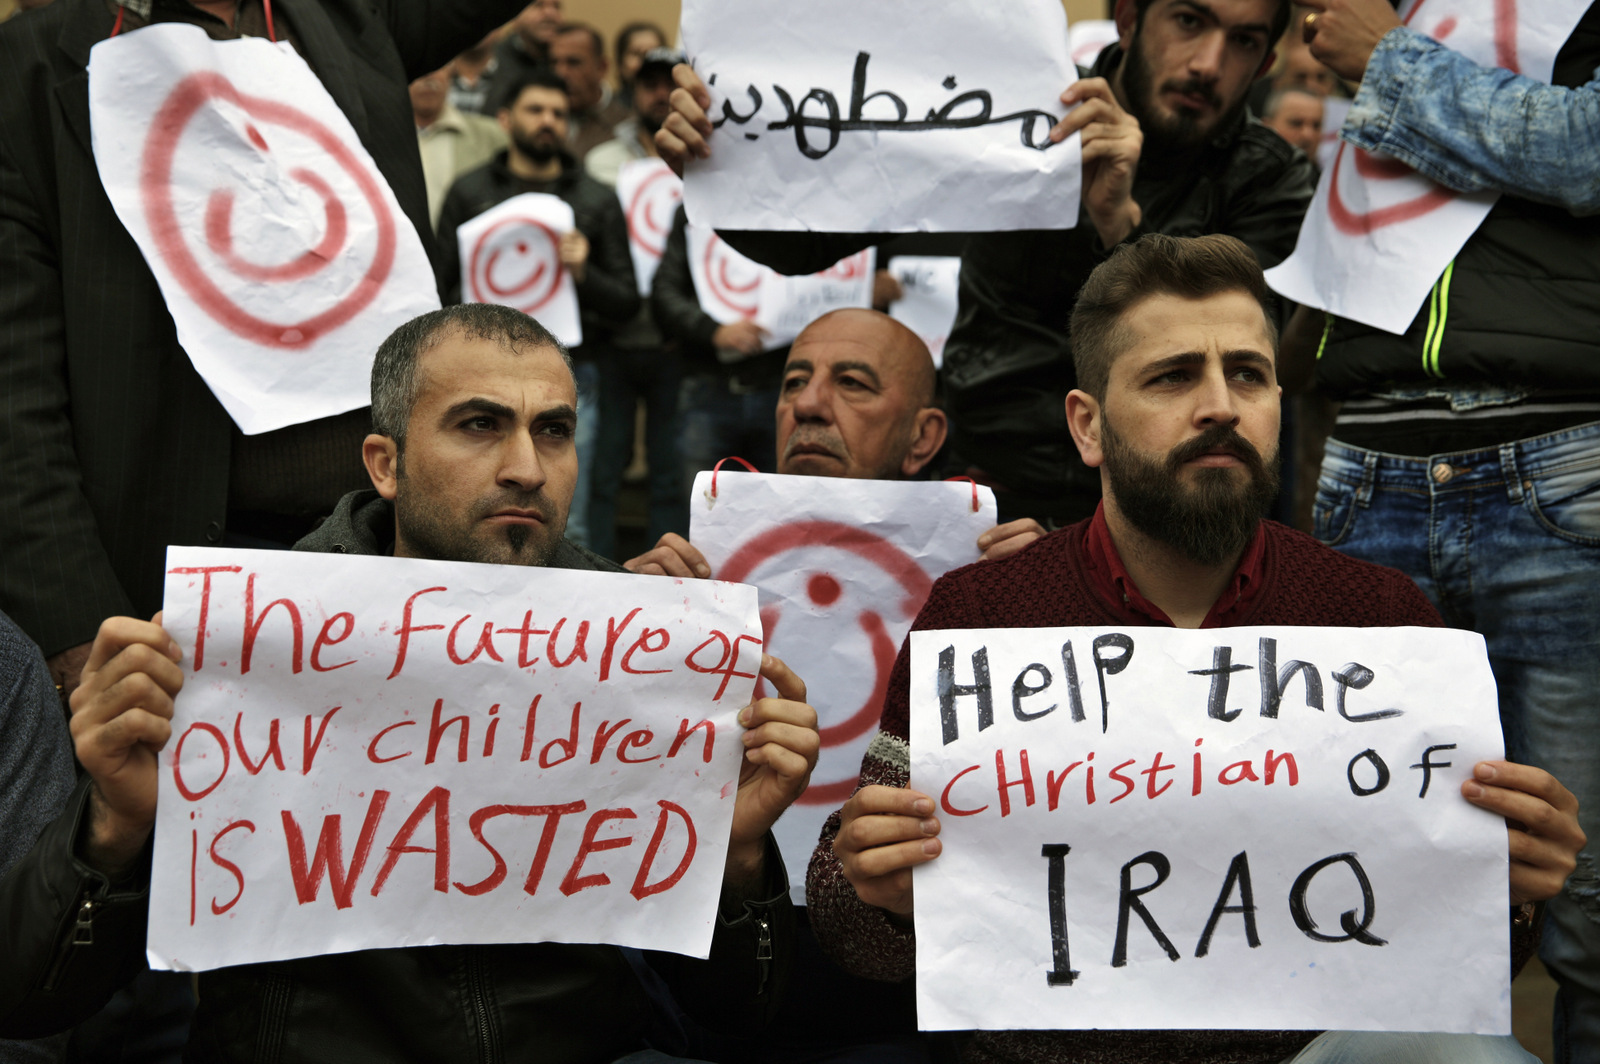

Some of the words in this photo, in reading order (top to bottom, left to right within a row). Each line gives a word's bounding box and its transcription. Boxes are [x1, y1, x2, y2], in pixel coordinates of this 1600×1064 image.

[168, 565, 359, 675] The
[386, 586, 673, 680] future
[685, 629, 763, 702] of
[938, 632, 1135, 746] Help
[1187, 636, 1405, 723] the
[366, 694, 715, 769] children
[188, 811, 256, 926] is
[281, 785, 698, 910] WASTED
[1041, 842, 1389, 987] IRAQ
